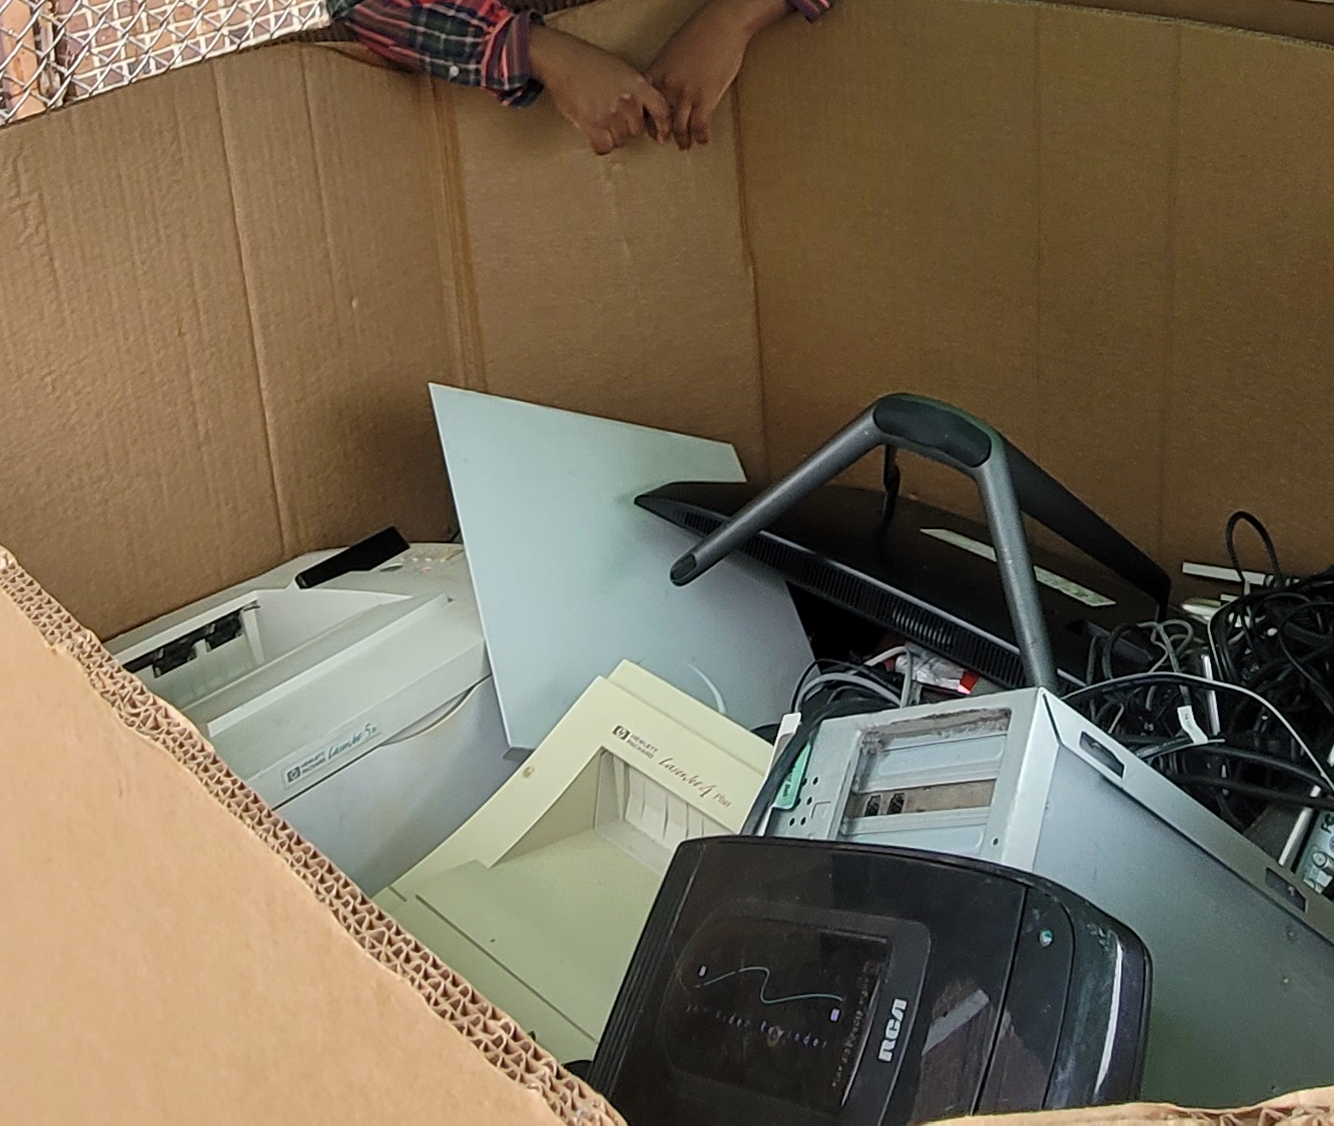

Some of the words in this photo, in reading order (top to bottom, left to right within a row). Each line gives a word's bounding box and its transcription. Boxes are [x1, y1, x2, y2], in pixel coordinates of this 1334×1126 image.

[627, 739, 654, 759] PACKARD
[629, 733, 658, 754] HEWLETT
[878, 998, 907, 1062] RCA
